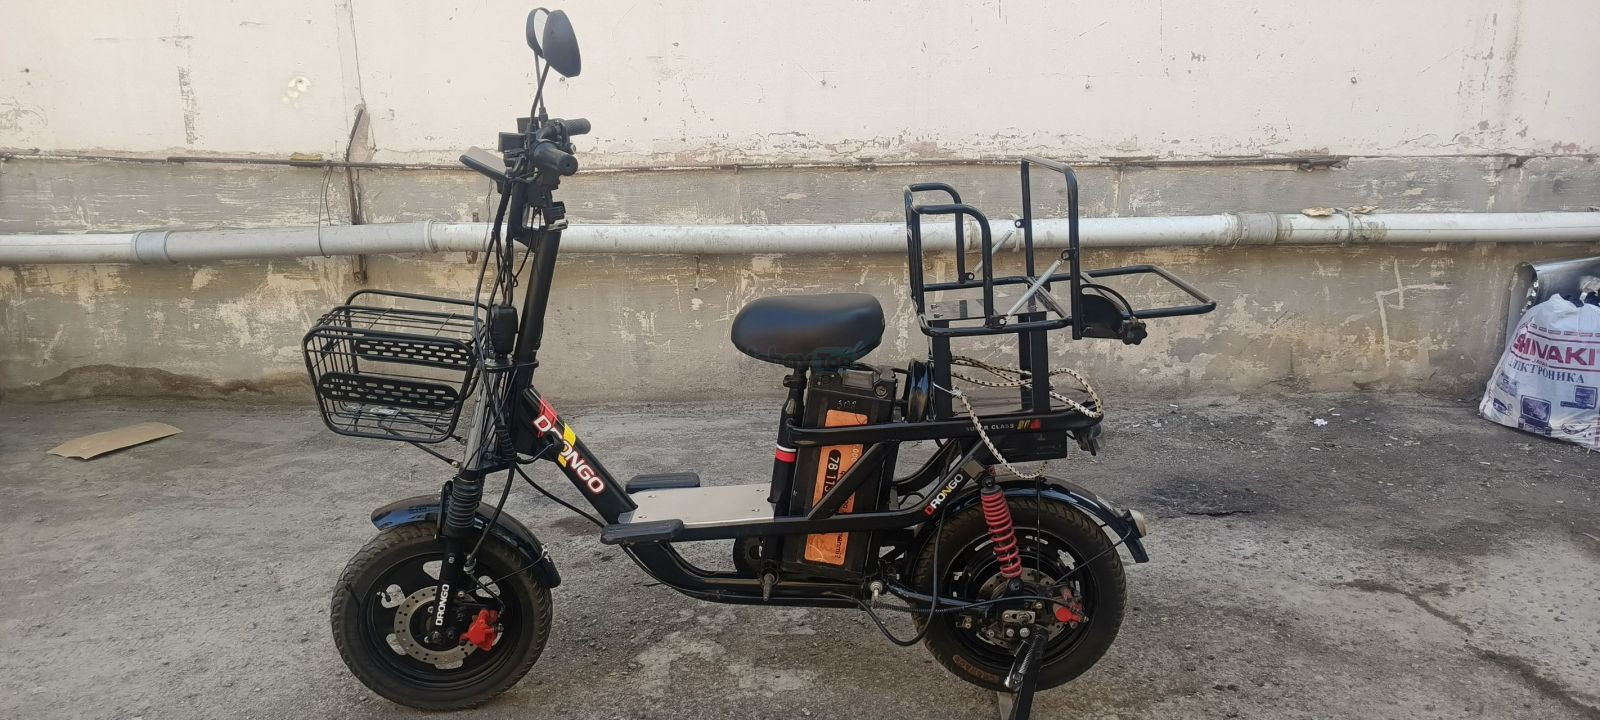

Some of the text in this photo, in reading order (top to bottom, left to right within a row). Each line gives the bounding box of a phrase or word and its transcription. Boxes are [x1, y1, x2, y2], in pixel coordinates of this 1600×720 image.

[828, 457, 840, 471] 78
[924, 473, 964, 515] DRONGO
[435, 584, 450, 626] DRONGO
